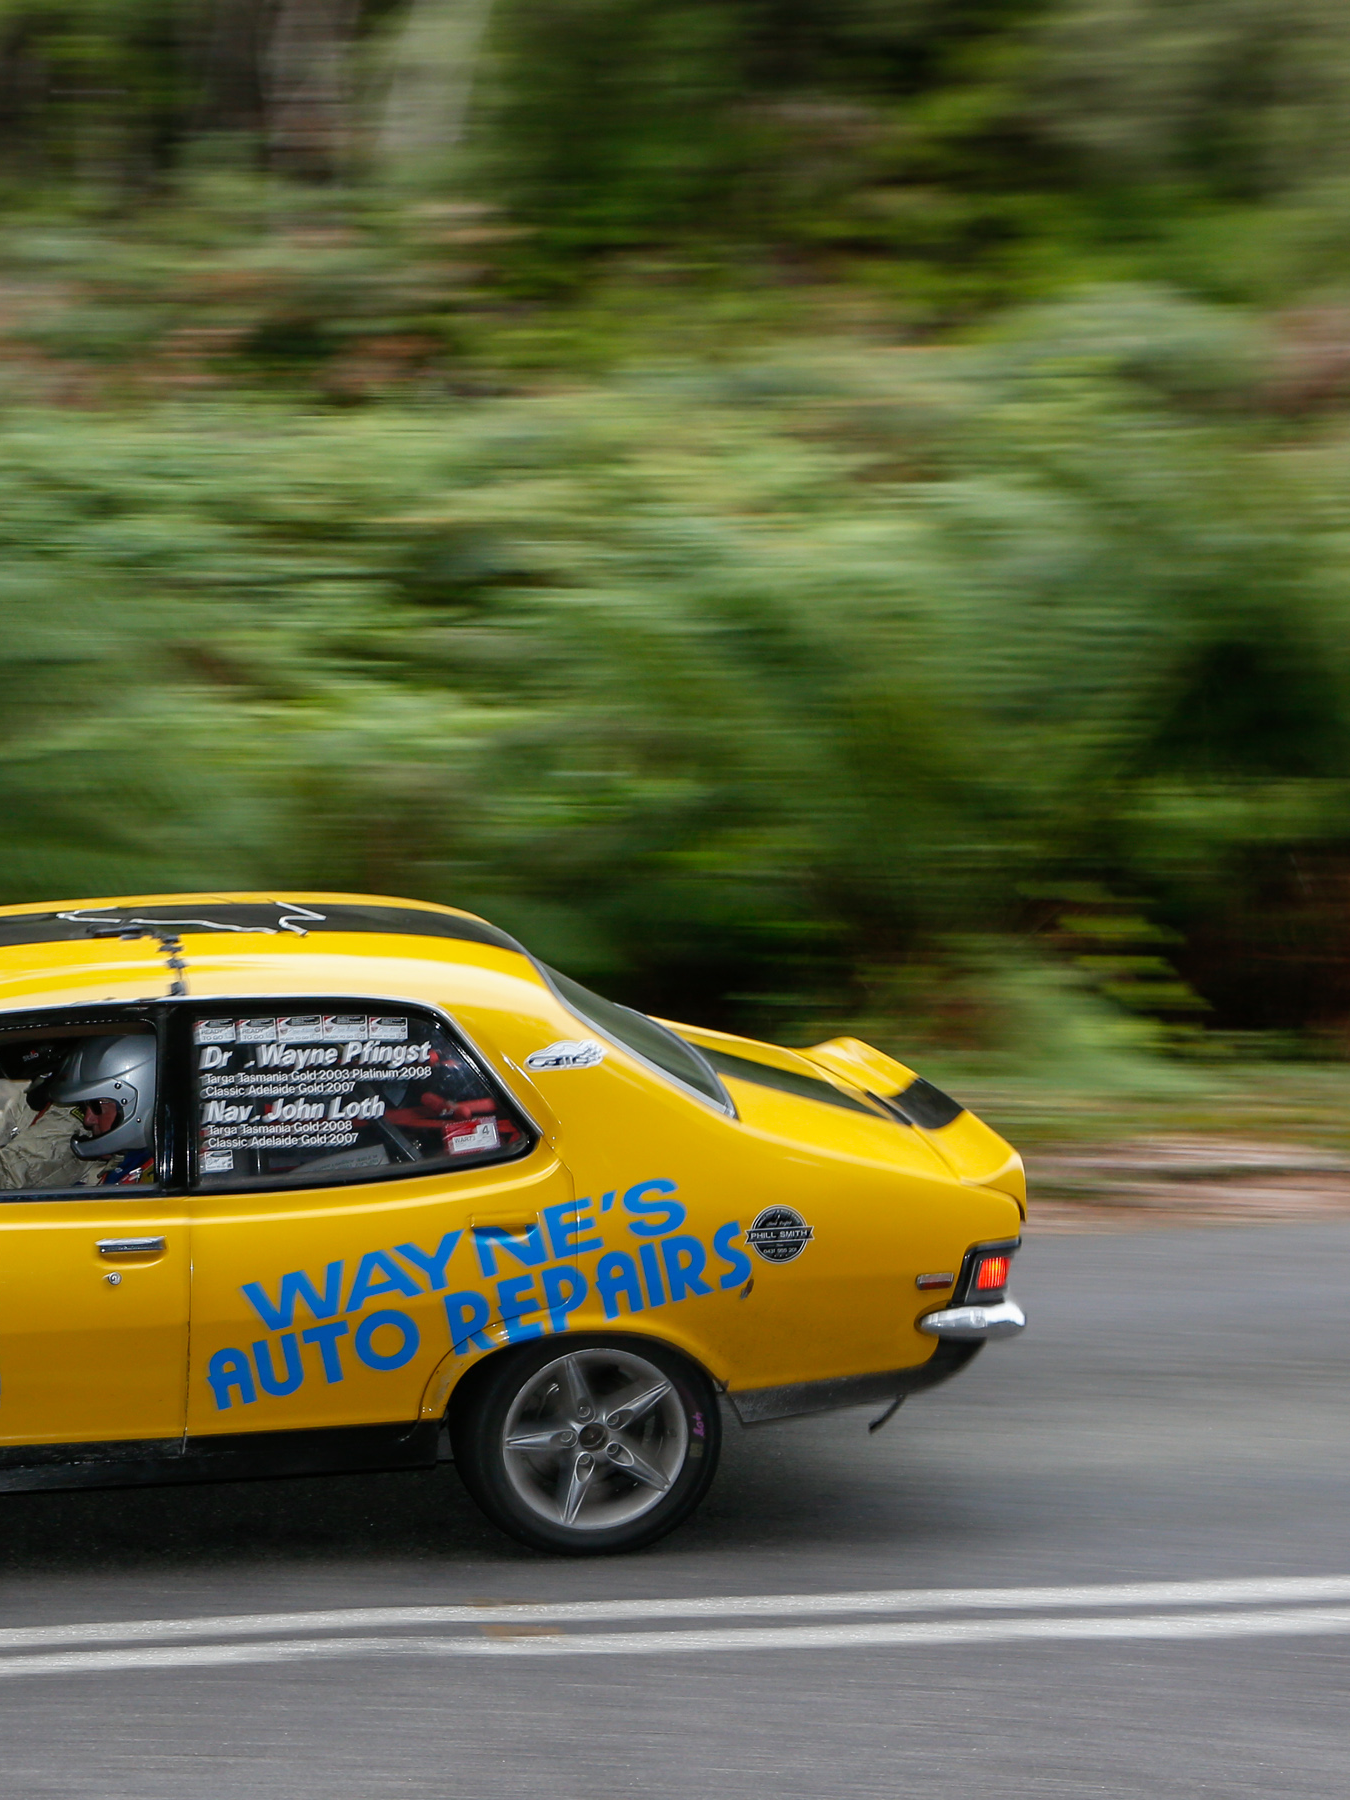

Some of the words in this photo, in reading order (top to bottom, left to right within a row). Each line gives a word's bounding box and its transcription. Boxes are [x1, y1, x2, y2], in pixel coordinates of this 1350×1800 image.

[258, 1043, 338, 1071] Wayne
[343, 1041, 431, 1068] Pfingst
[205, 1073, 235, 1085] Targa
[238, 1071, 288, 1083] Tasmania
[291, 1070, 317, 1081] Gold
[319, 1068, 350, 1080] 2003
[352, 1068, 399, 1079] Platinum
[400, 1066, 432, 1078] 2008
[205, 1085, 245, 1097] Classic
[248, 1084, 296, 1096] Adelaide
[298, 1083, 324, 1094] Gold
[326, 1082, 356, 1093] 2007
[265, 1098, 325, 1121] John
[329, 1095, 385, 1120] Loth
[208, 1124, 238, 1137] Targa
[241, 1123, 291, 1135] Tasmania
[294, 1121, 320, 1133] Gold
[322, 1120, 353, 1132] 2008
[208, 1137, 248, 1149] Classic
[250, 1135, 298, 1147] Adelaide
[301, 1134, 327, 1145] Gold
[329, 1133, 359, 1144] 2007
[780, 1230, 808, 1238] SMITH
[241, 1177, 688, 1332] WAYNE'S
[206, 1309, 420, 1410] AUTO
[443, 1220, 752, 1357] REPAIRS
